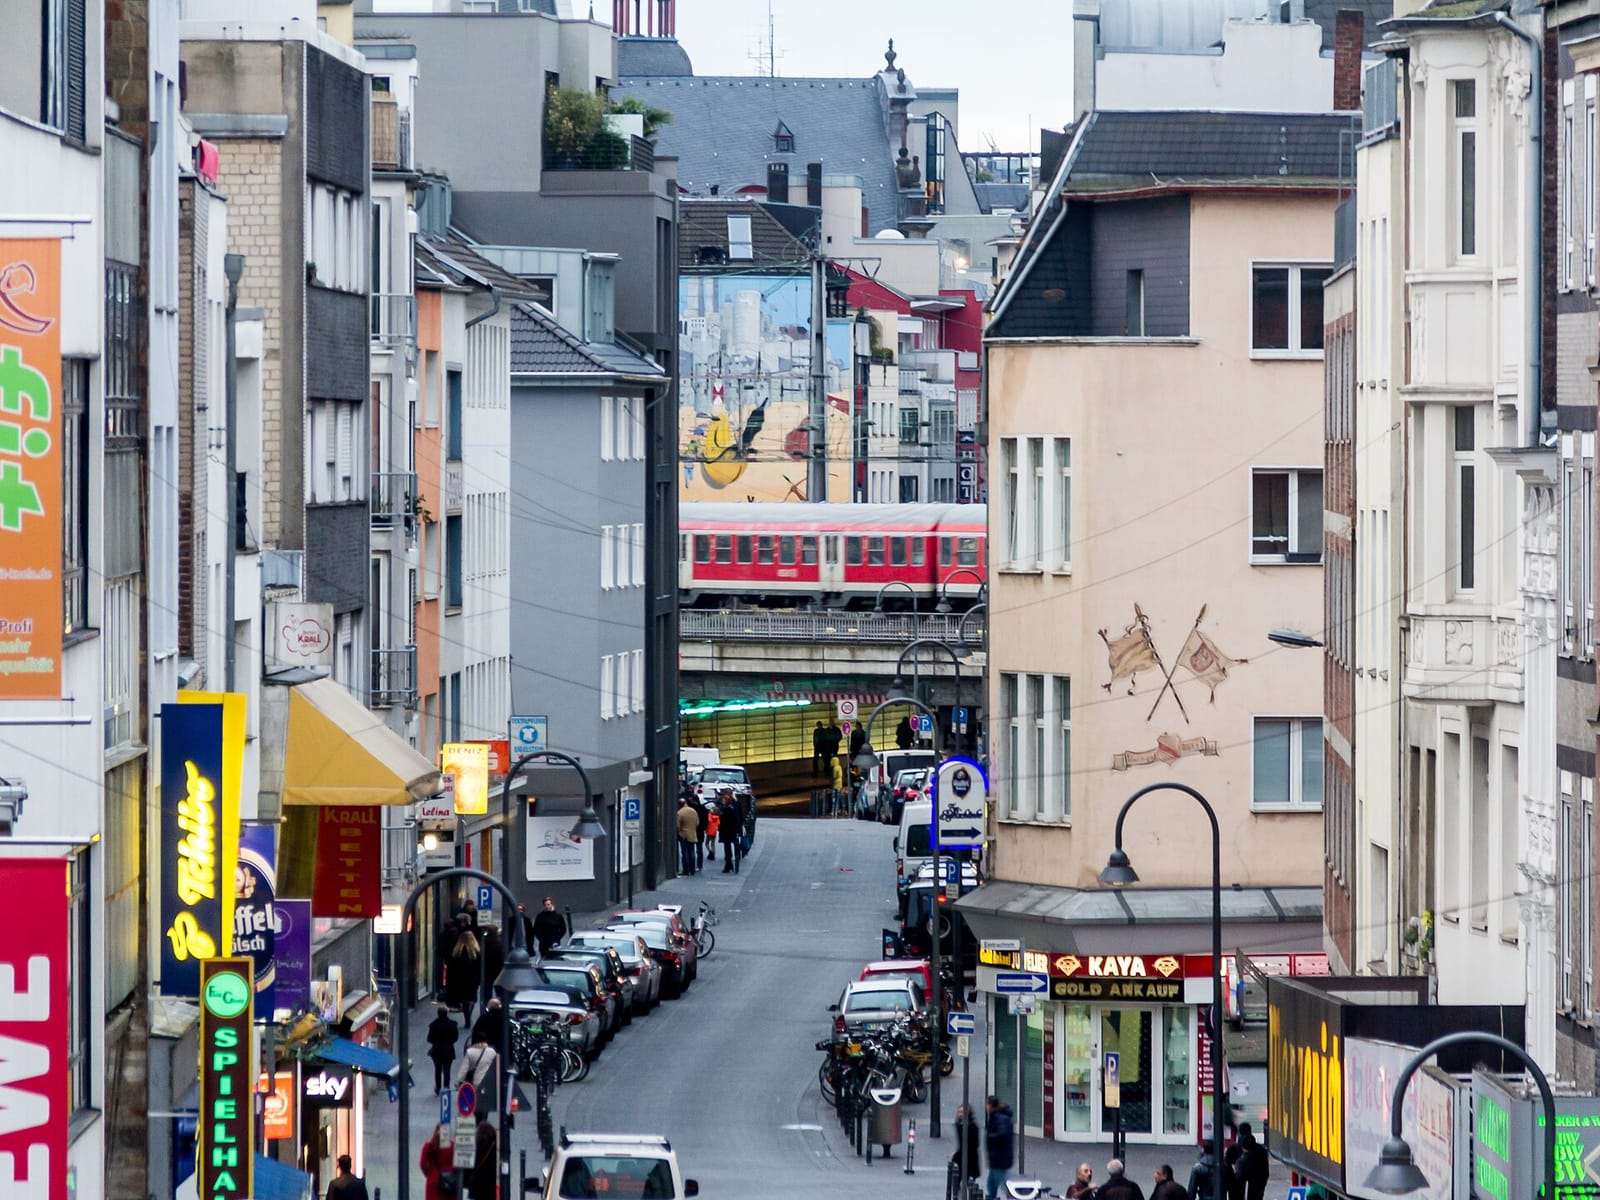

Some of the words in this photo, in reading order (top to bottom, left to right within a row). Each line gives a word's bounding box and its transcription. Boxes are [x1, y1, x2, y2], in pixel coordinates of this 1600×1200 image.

[0, 344, 52, 532] fit
[0, 618, 32, 633] Profi
[298, 634, 321, 643] KRALL
[324, 806, 377, 824] KRALL
[338, 827, 362, 913] BETTEN
[480, 888, 489, 907] P
[234, 903, 275, 936] ffel
[1011, 951, 1049, 975] JUELIER
[1088, 956, 1147, 976] KAYA
[1055, 982, 1102, 997] GOLD
[1109, 983, 1180, 998] ANKAUF
[306, 1072, 348, 1100] sky
[212, 1026, 239, 1200] SPIELHA
